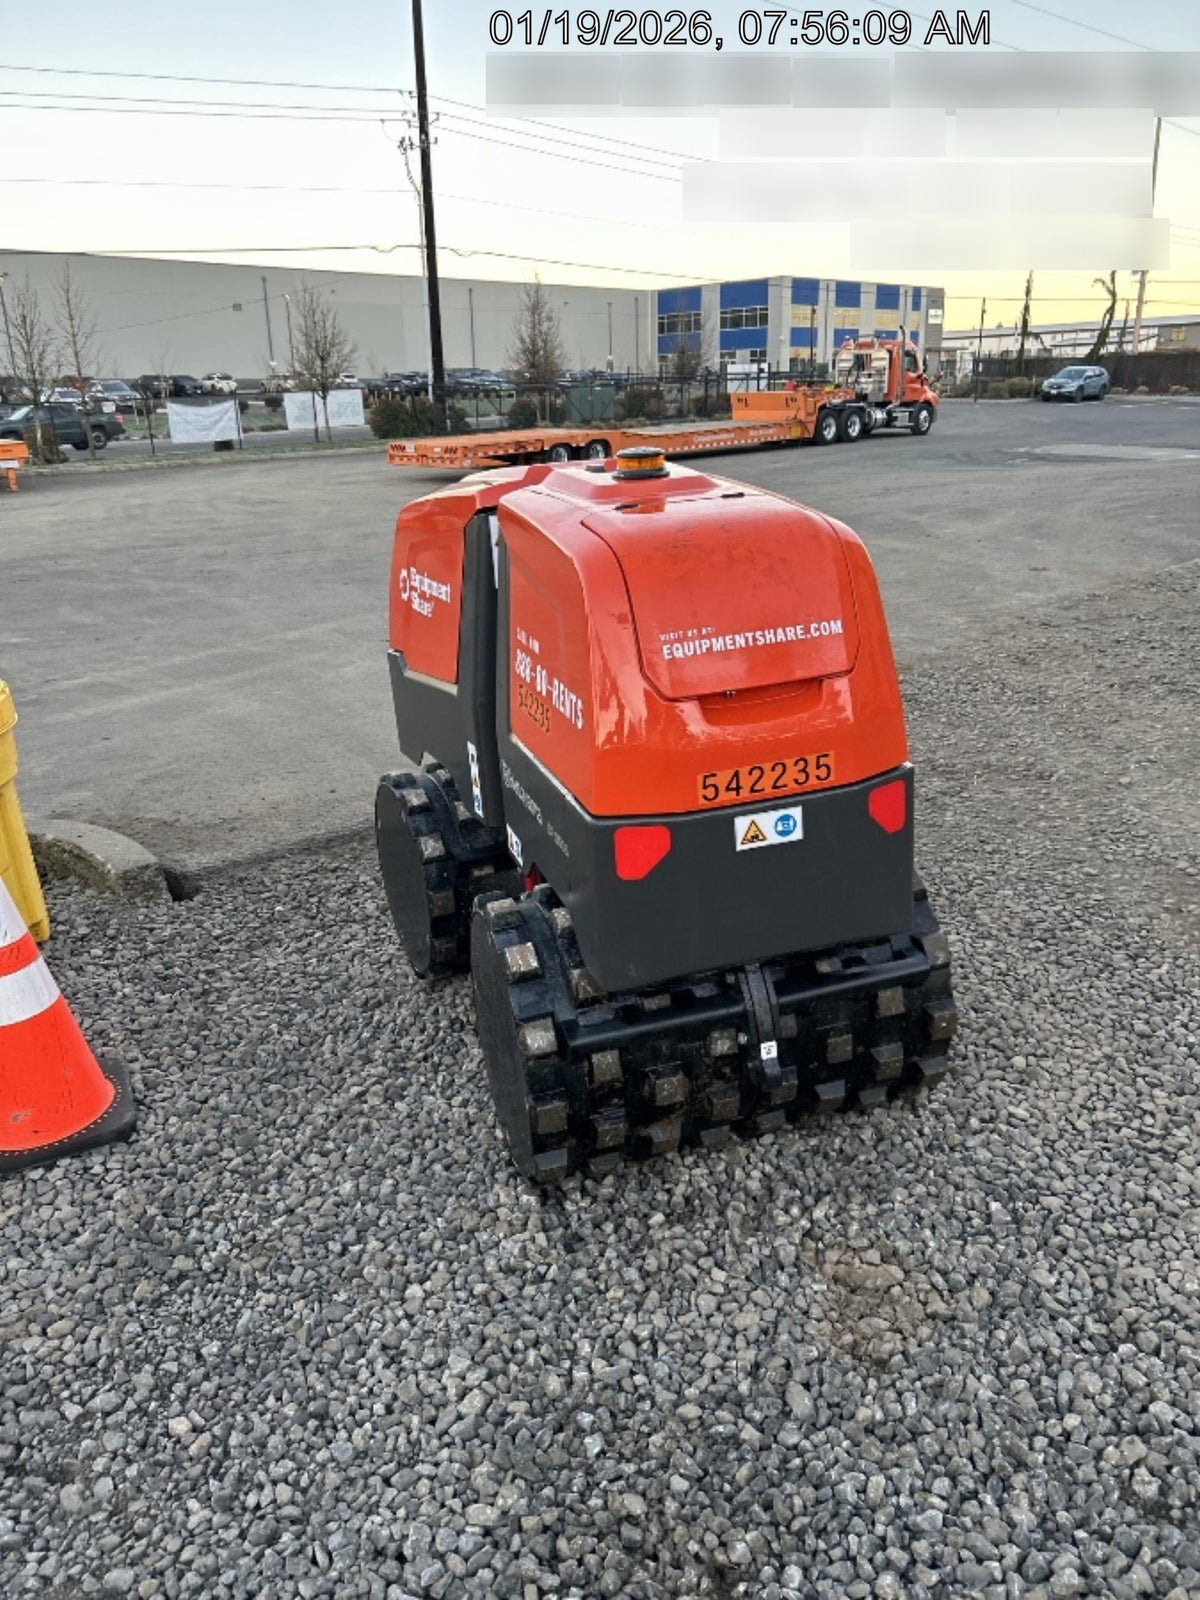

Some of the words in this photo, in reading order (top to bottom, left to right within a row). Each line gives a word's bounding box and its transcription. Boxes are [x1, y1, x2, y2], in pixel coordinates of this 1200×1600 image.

[410, 566, 451, 604] Equipment
[662, 620, 844, 660] EQUIPMENTSHARE.COM
[518, 684, 550, 734] 542235
[701, 753, 832, 802] 542235
